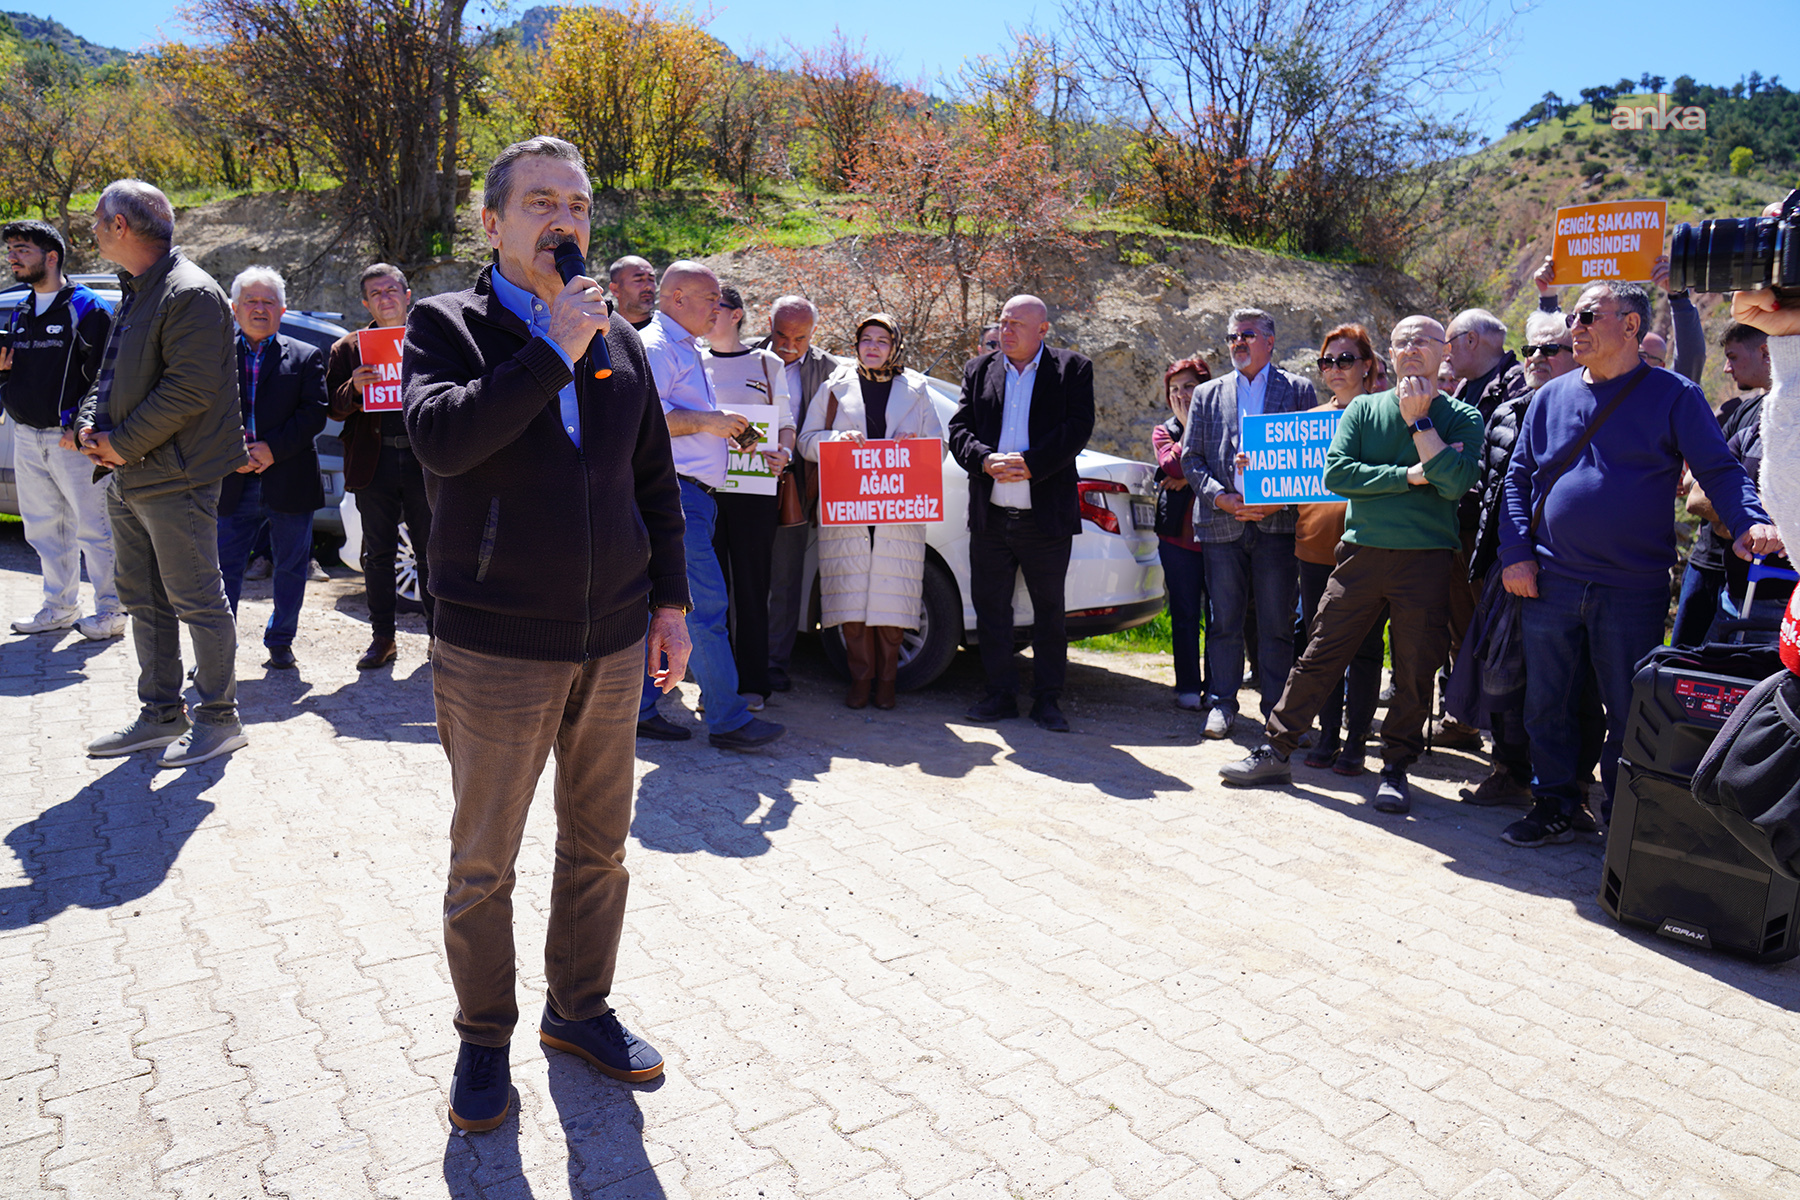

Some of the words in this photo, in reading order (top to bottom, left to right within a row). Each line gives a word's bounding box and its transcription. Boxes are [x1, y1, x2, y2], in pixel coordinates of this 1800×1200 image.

[1558, 212, 1595, 236] CENGİZ
[1598, 211, 1660, 232] SAKARYA
[1568, 233, 1641, 256] VADİSİNDEN
[1582, 258, 1621, 277] DEFOL
[852, 449, 882, 469] TEK
[885, 444, 911, 468] BİR
[1245, 449, 1297, 471] MADEN
[859, 470, 904, 495] AĞACI
[1261, 475, 1336, 497] OLMAYAC
[826, 494, 939, 521] VERMEYECEĞİZ
[1664, 924, 1705, 940] KORAX
